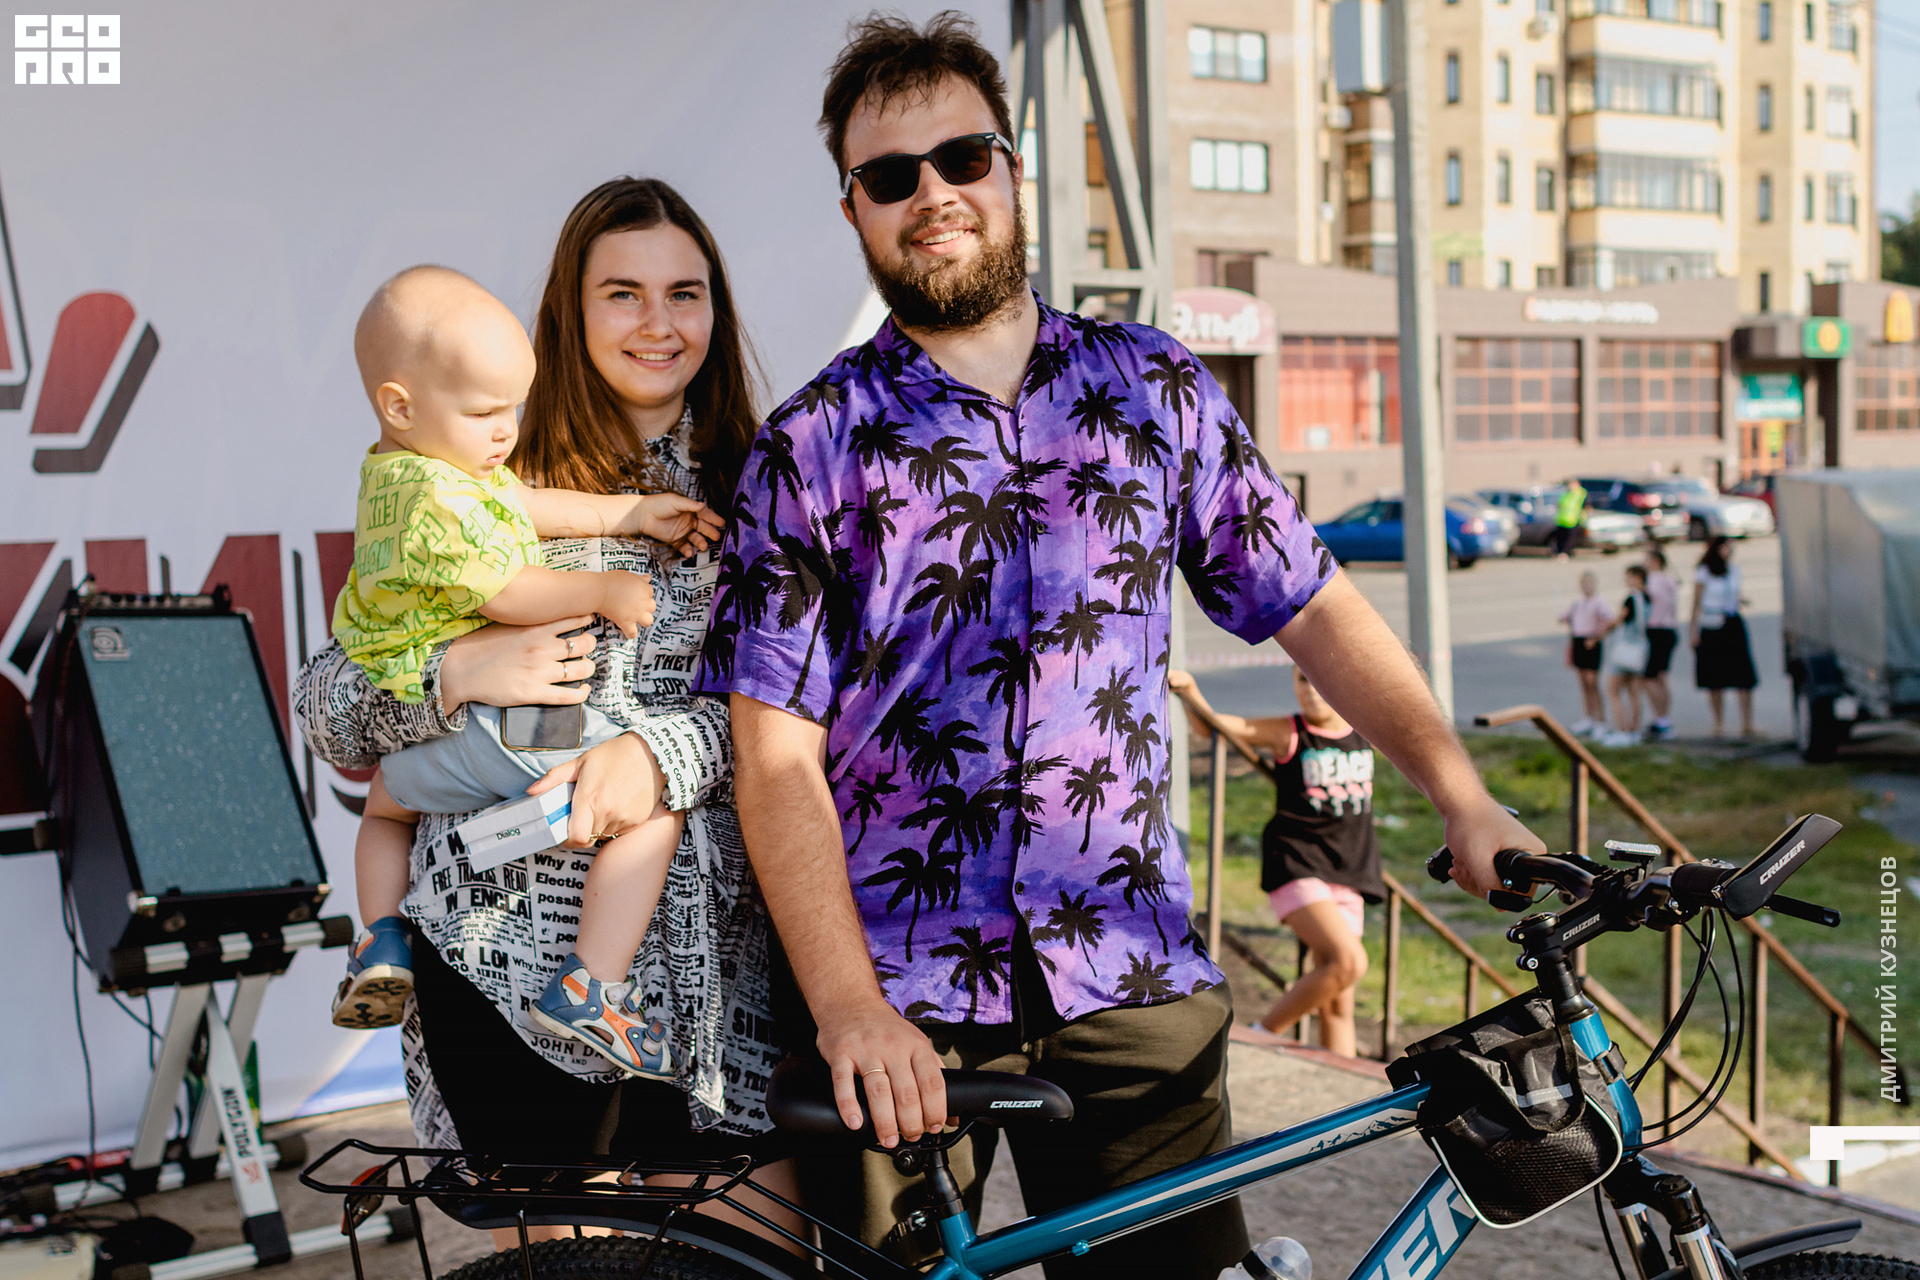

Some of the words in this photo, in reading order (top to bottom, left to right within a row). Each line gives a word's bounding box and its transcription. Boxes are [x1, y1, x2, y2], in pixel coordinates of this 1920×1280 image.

[653, 654, 698, 673] THEY
[495, 827, 521, 841] Dialog
[534, 853, 566, 871] Why
[570, 860, 590, 873] do
[1758, 838, 1807, 886] CRUZER
[502, 866, 528, 894] READ
[1562, 913, 1601, 942] CRUZER
[512, 955, 534, 972] Why
[530, 1035, 575, 1056] JOHN
[989, 1099, 1044, 1109] CRUZER
